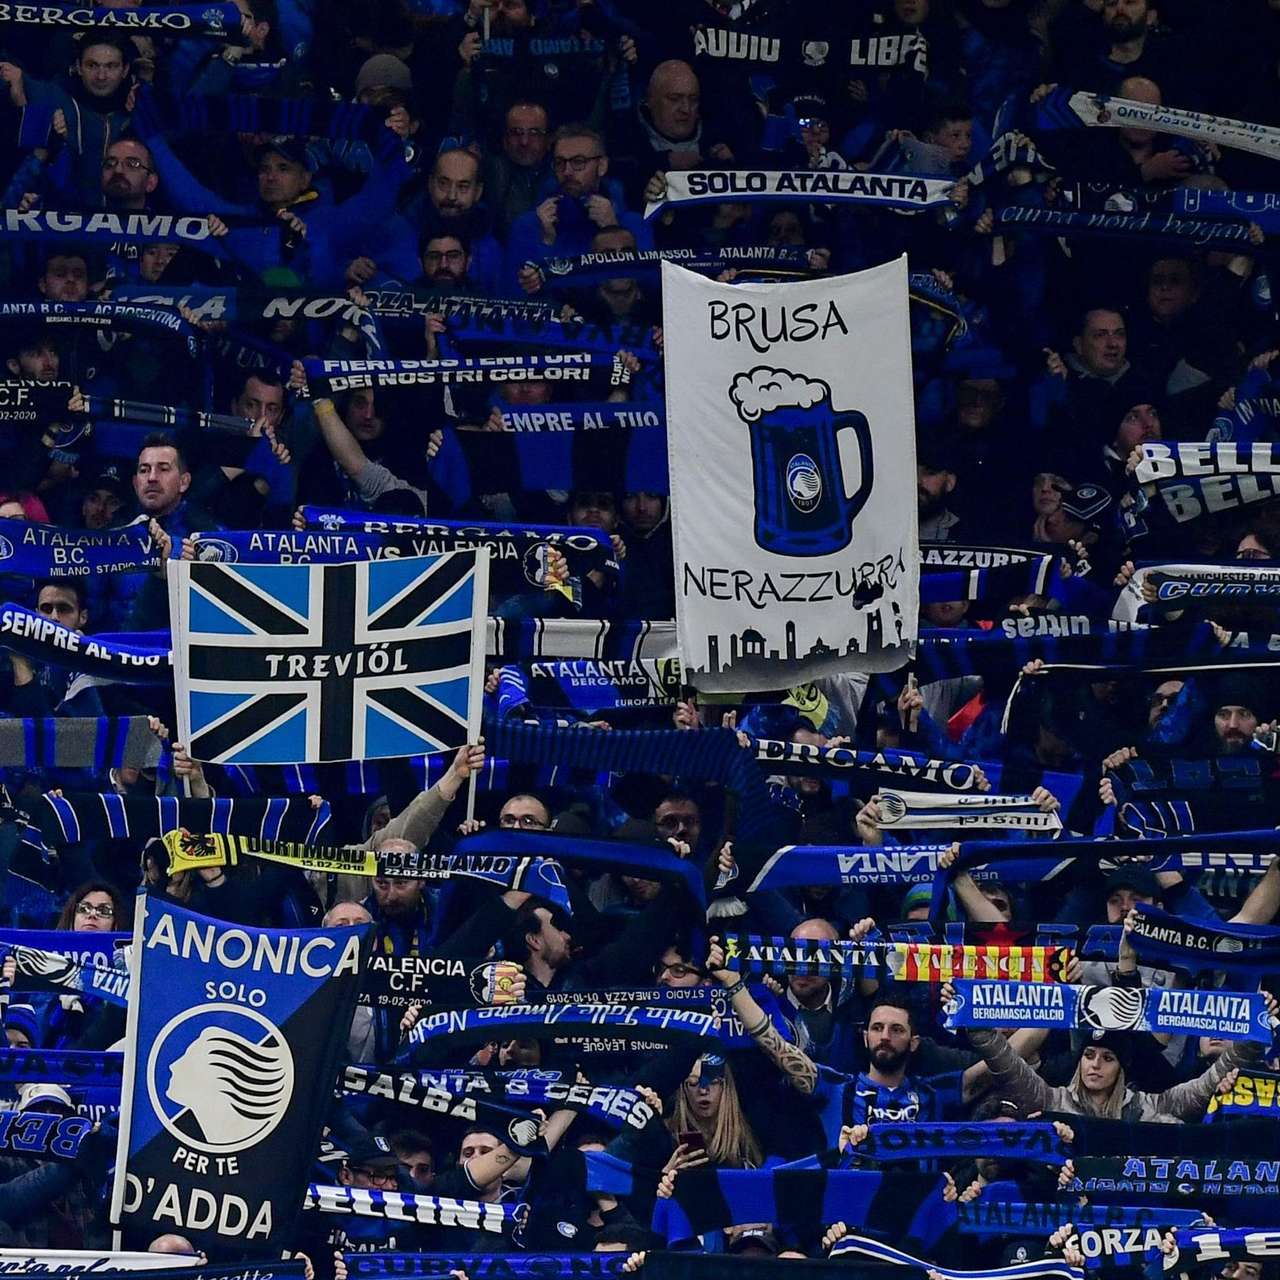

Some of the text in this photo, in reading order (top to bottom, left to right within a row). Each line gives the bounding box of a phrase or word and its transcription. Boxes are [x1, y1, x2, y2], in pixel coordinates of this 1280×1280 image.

[687, 171, 928, 201] SOLO ATALANTA
[580, 247, 776, 266] APOLLON LIMASSOL ATALANTA
[113, 305, 182, 330] FIORENTINA
[707, 300, 849, 352] BRUSA
[330, 368, 592, 391] DEI NOSTRI COLORI
[249, 532, 359, 557] ATALANTA
[0, 603, 112, 661] SEMPRE AL
[266, 641, 409, 679] TREVIÖL
[142, 908, 362, 978] ANONICA
[745, 945, 879, 967] ATALANTA
[205, 979, 267, 1008] SOLO
[973, 980, 1065, 1010] ATALANTA
[1158, 990, 1251, 1022] ATALANTA
[972, 1006, 1065, 1021] BERGAMASCA CALCIO
[1158, 1013, 1250, 1034] BERGAMASCA CALCIO
[173, 1146, 240, 1176] PER TE
